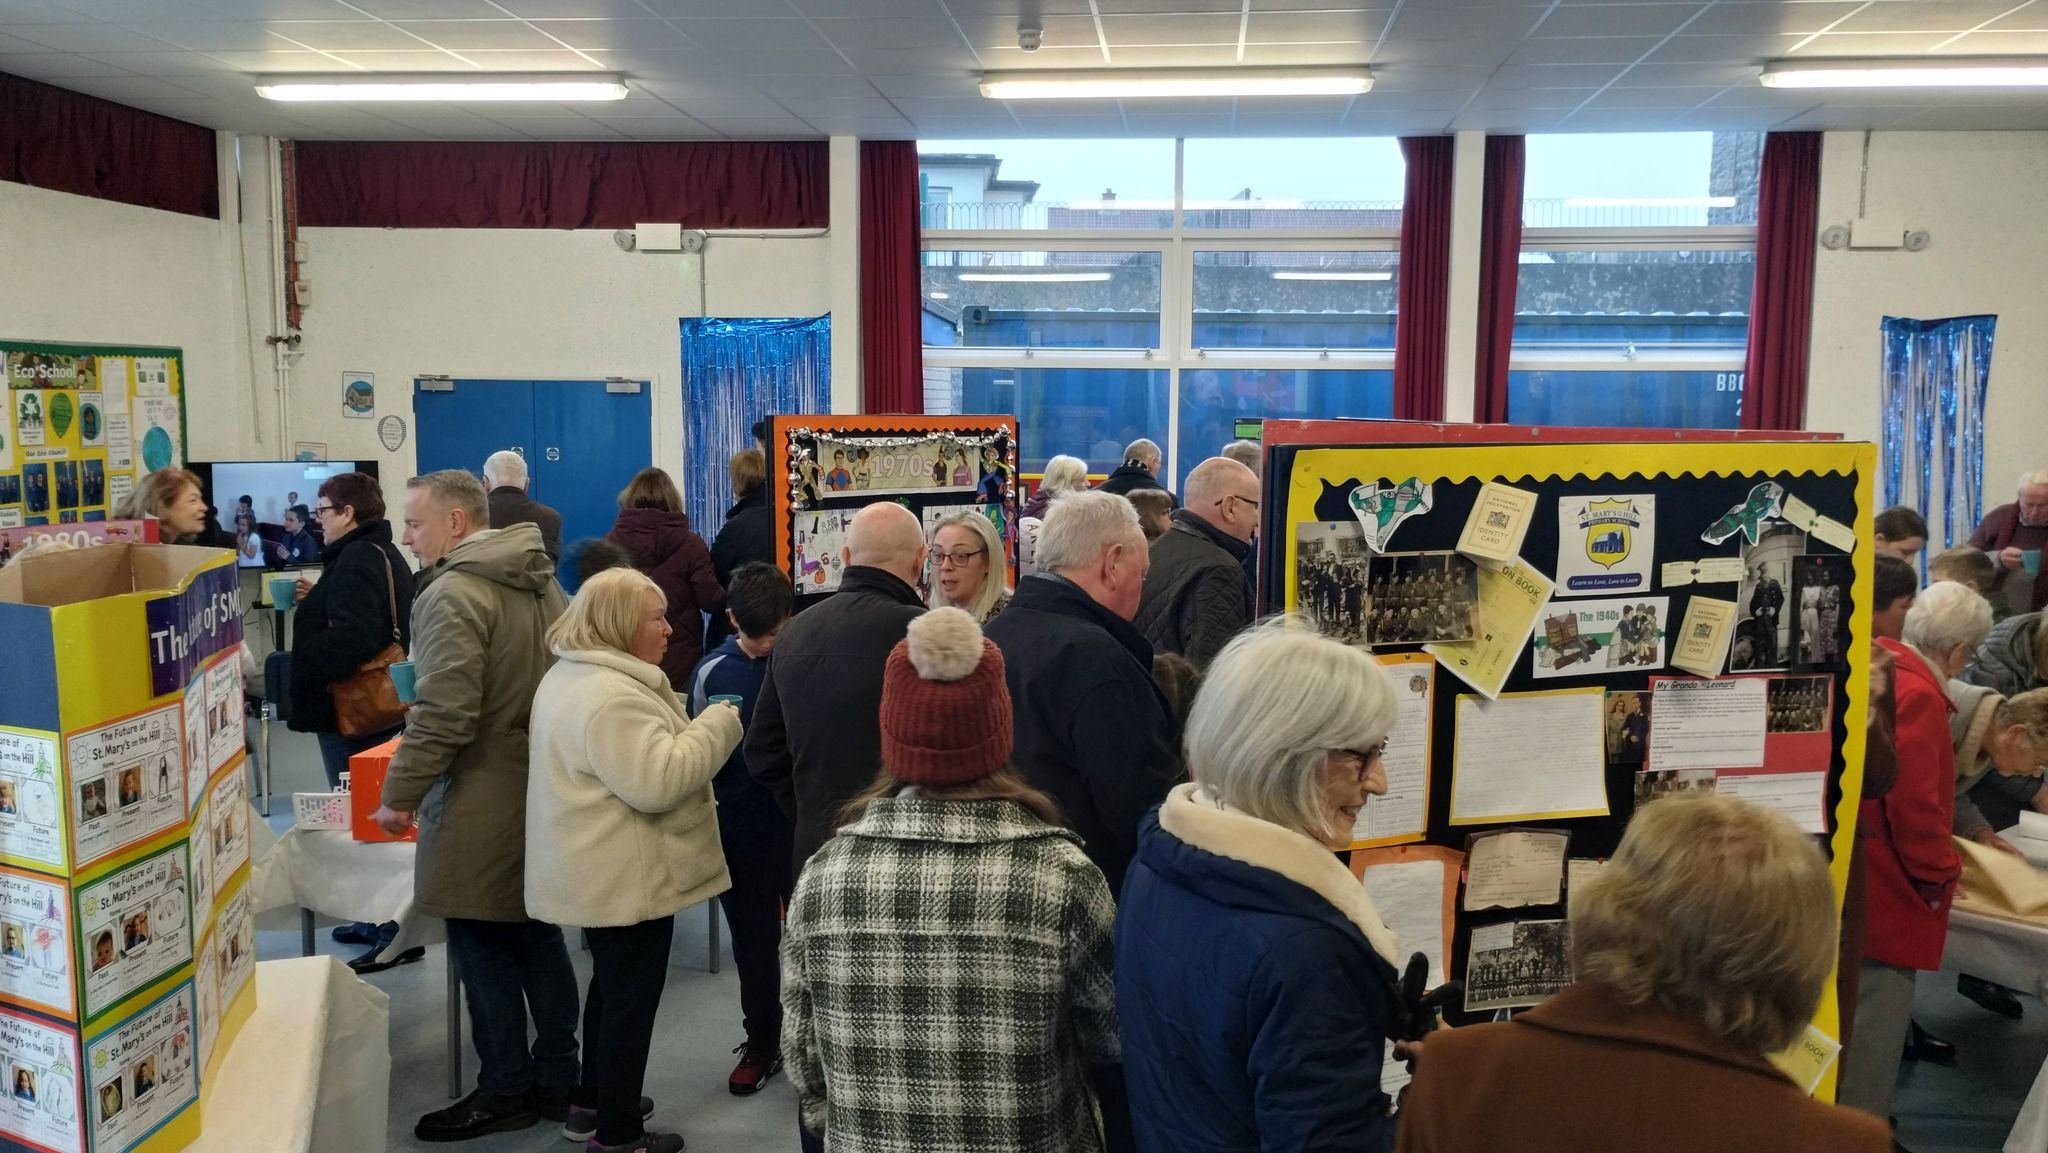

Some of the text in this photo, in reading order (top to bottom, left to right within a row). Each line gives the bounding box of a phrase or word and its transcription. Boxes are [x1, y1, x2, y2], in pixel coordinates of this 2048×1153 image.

[14, 363, 77, 378] Eco School
[871, 453, 934, 479] 1970s
[1516, 577, 1541, 599] BOOK
[1579, 610, 1620, 622] The 1940s
[151, 624, 189, 665] The
[204, 593, 218, 637] of
[1655, 681, 1668, 691] My
[1670, 681, 1698, 689] Granda
[1706, 679, 1736, 689] Leonard
[100, 721, 147, 742] The Future of
[139, 736, 148, 745] the
[149, 730, 161, 741] Hill
[12, 752, 21, 762] the
[22, 751, 34, 765] Hill
[108, 863, 154, 892] The Future of
[145, 878, 154, 889] the
[155, 870, 166, 883] Hill
[23, 884, 30, 894] of
[20, 897, 30, 907] the
[31, 897, 43, 911] Hill
[9, 1020, 32, 1036] Future
[34, 1030, 41, 1039] of
[118, 1008, 161, 1042] The Future of
[153, 1024, 161, 1034] the
[162, 1013, 173, 1027] Hill
[32, 1041, 42, 1052] the
[42, 1043, 55, 1057] Hill
